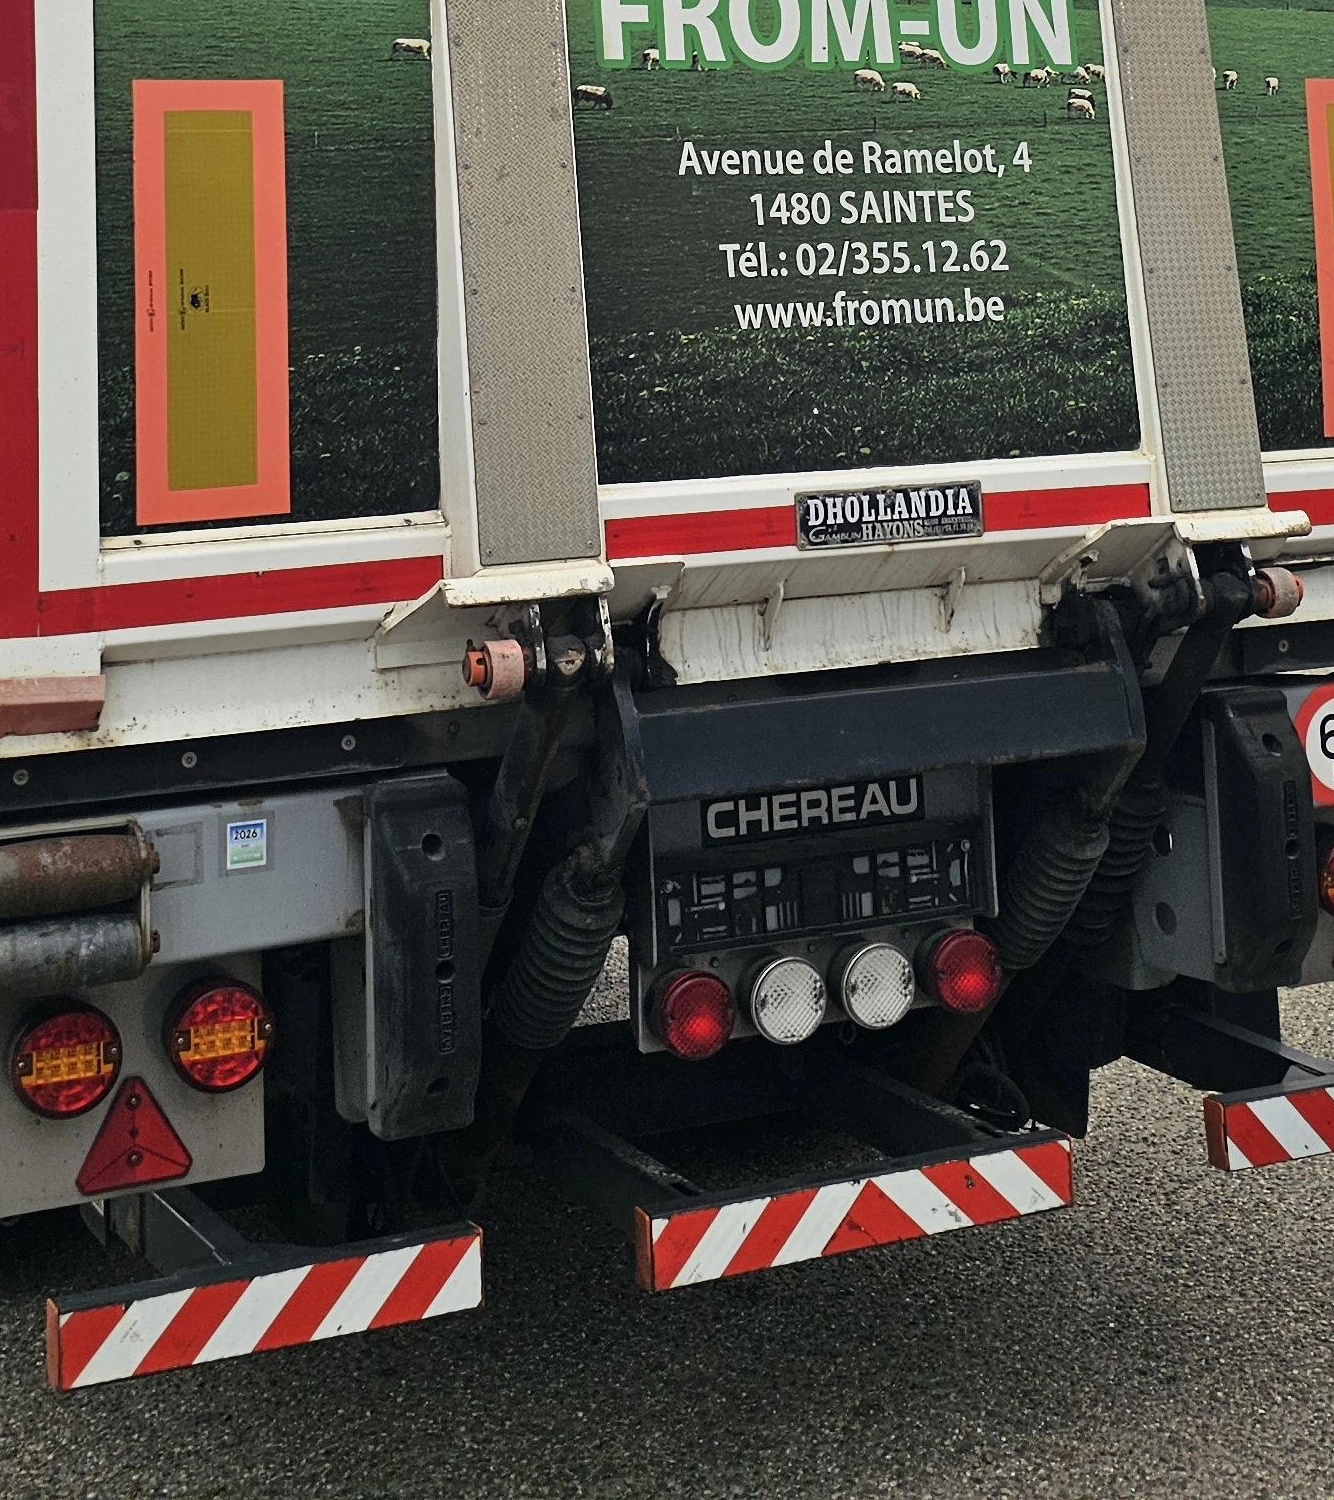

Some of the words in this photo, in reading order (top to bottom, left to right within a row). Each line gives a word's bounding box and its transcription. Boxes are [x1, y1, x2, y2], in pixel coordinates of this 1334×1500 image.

[678, 141, 804, 176] Avenue
[813, 140, 854, 174] de
[862, 140, 1006, 178] Ramelot,
[1012, 141, 1032, 173] 4
[750, 192, 831, 226] 1480
[840, 190, 975, 224] SAINTES
[719, 241, 788, 278] Tél.:
[796, 239, 1010, 276] 02/355.12.62
[734, 288, 1005, 330] www.fromun.be
[807, 488, 973, 526] DHOLLANDIA
[861, 519, 925, 541] HAYONS
[707, 778, 918, 839] CHEREAU
[234, 829, 258, 840] 2026
